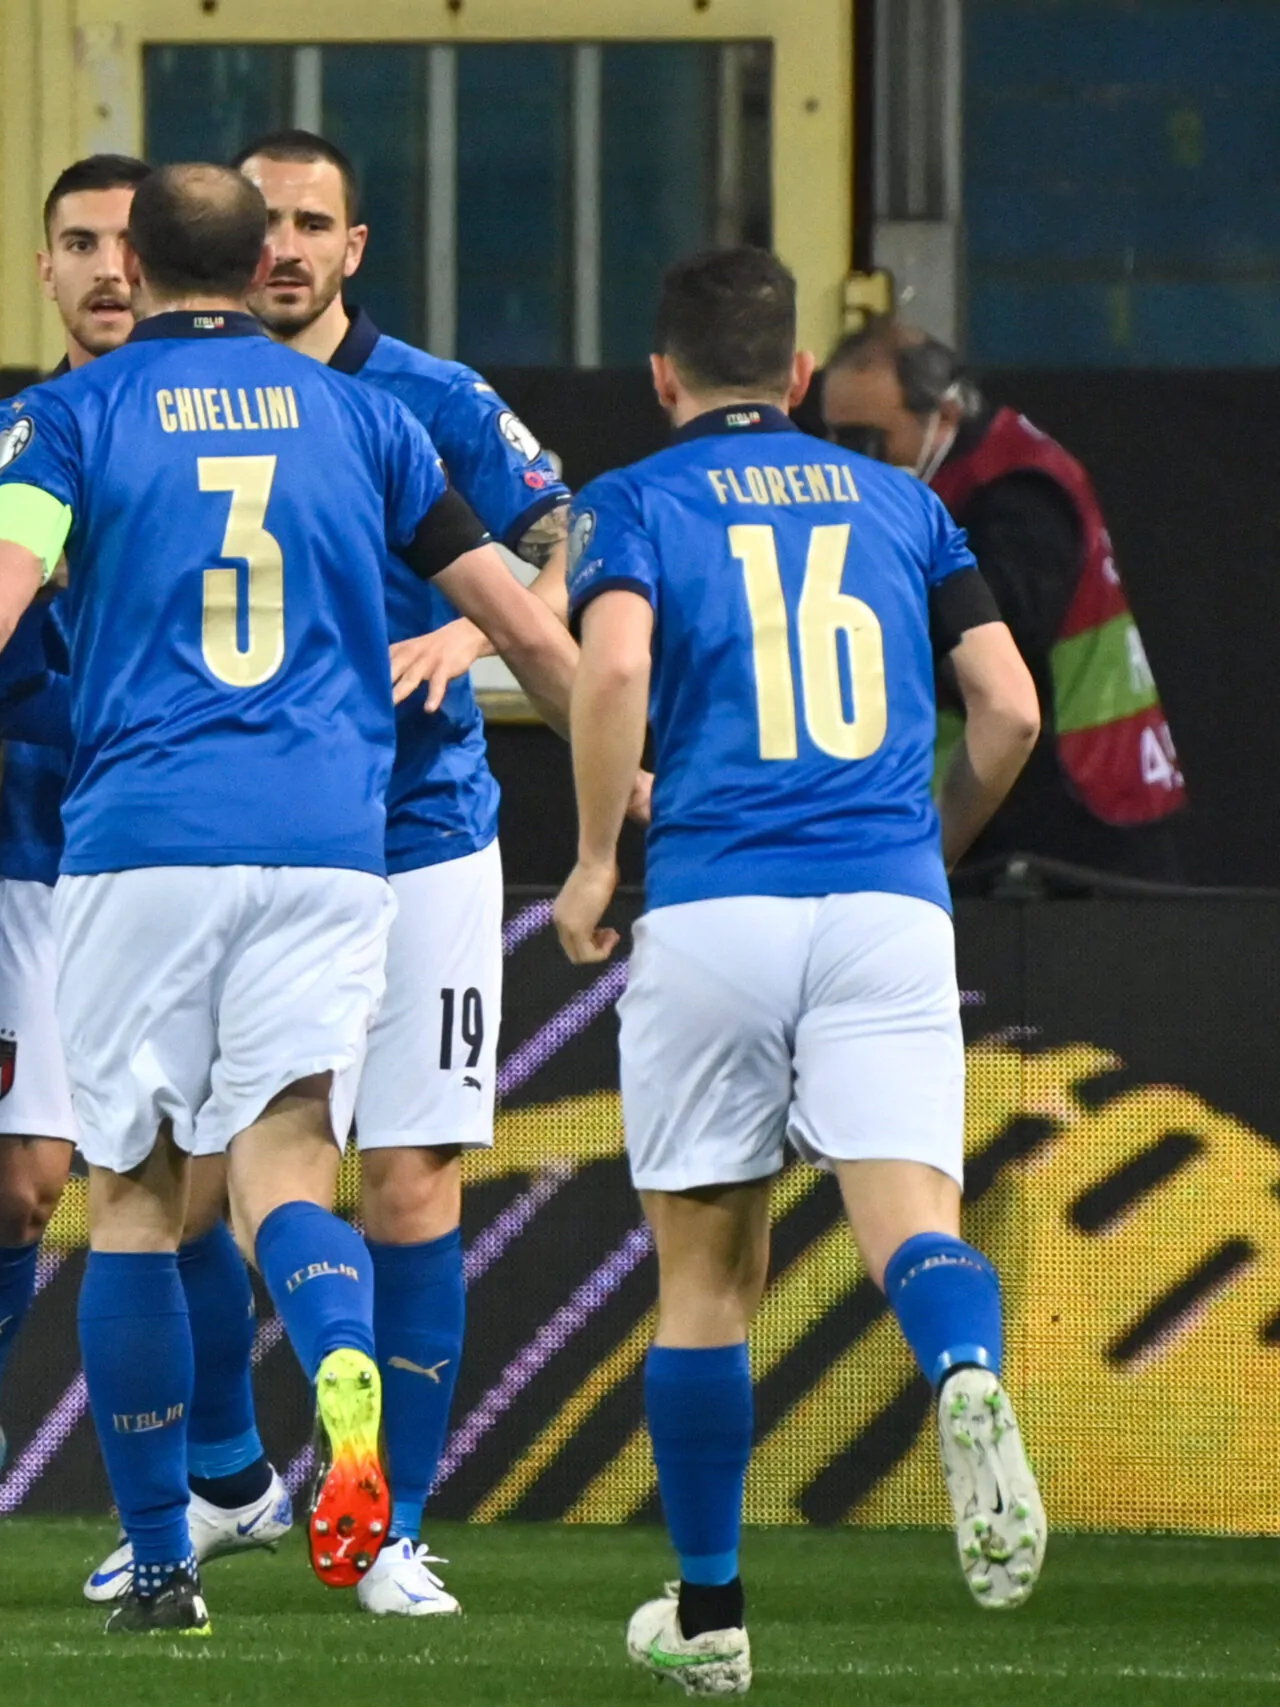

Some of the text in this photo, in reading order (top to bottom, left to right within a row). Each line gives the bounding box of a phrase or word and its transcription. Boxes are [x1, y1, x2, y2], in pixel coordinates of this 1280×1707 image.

[156, 385, 300, 433] CHIELLINI
[707, 464, 860, 506] FLORENZI
[197, 455, 285, 687] 3
[727, 523, 888, 761] 16
[439, 986, 484, 1070] 19
[286, 1260, 360, 1294] ITALIA
[112, 1402, 184, 1433] ITALIA
